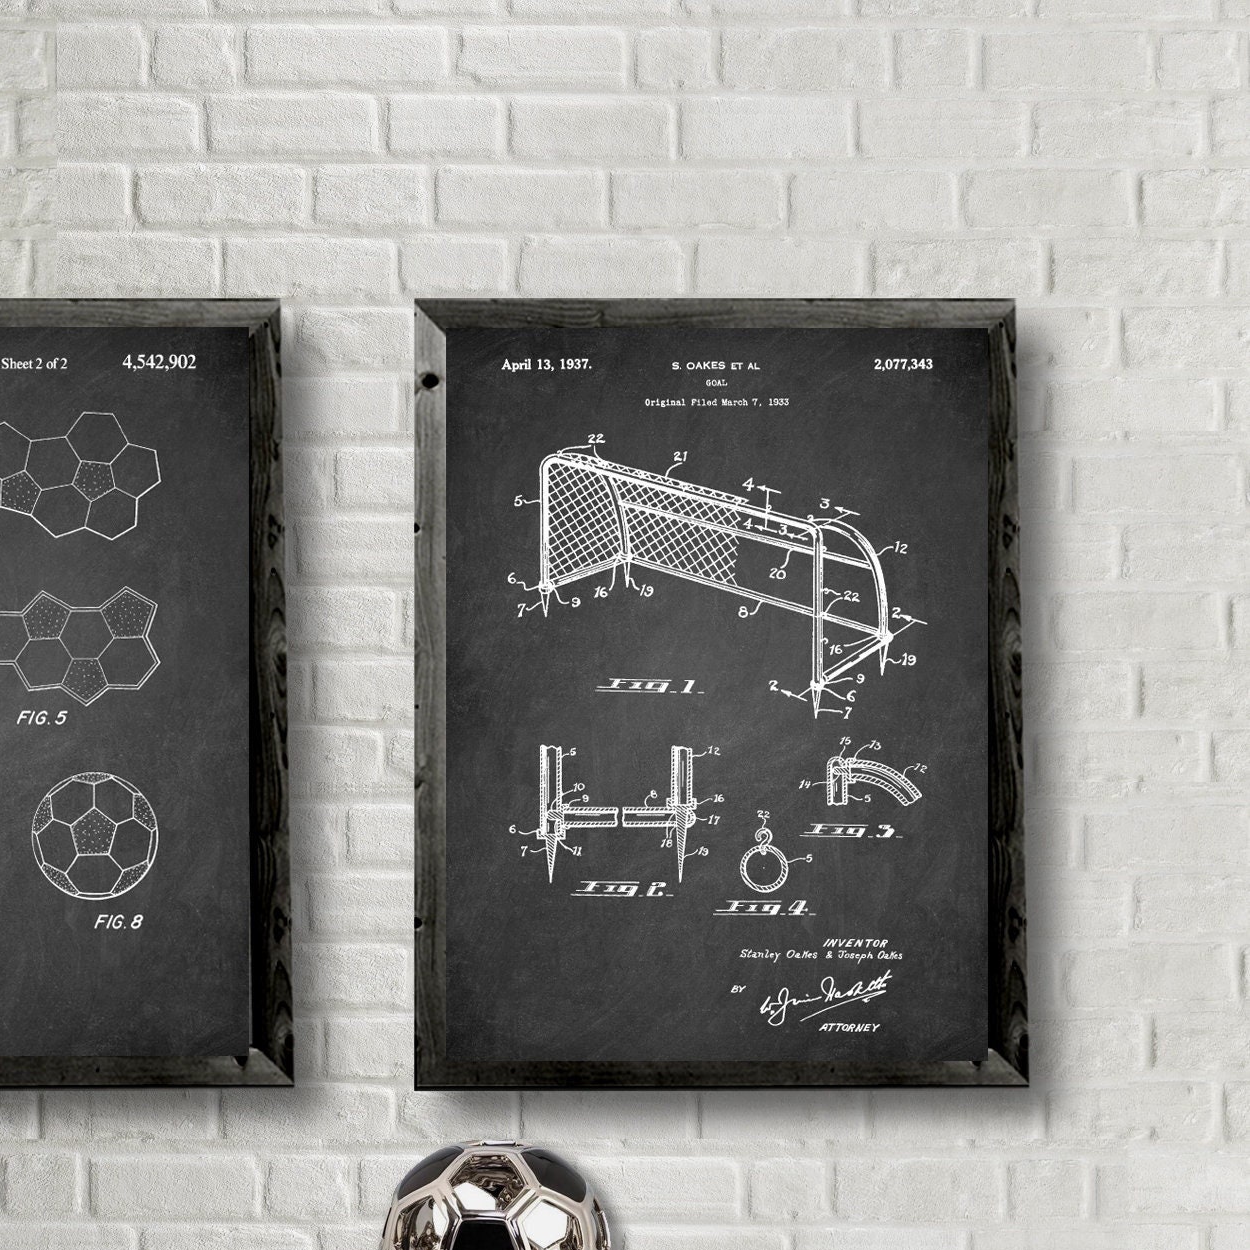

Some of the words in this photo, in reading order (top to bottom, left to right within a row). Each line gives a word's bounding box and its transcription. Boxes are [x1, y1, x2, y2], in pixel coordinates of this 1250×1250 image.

[0, 357, 34, 370] Sheet
[35, 357, 43, 370] 2
[45, 357, 60, 370] of
[59, 357, 68, 370] 2
[121, 353, 197, 372] 4,542,902
[500, 357, 532, 373] April
[536, 358, 555, 372] 13,
[559, 358, 593, 370] 1937.
[671, 361, 682, 371] S.
[685, 360, 726, 371] OAKES
[730, 361, 744, 371] ET
[747, 361, 761, 371] AL
[873, 358, 934, 372] 2,077,343
[705, 378, 728, 387] GOAL
[644, 397, 686, 408] Original
[690, 397, 718, 407] Filed
[721, 397, 749, 407] March
[751, 397, 762, 408] 7,
[768, 397, 790, 407] 1933
[587, 432, 606, 445] 22
[673, 450, 688, 462] 21
[741, 476, 755, 492] 4
[513, 494, 525, 507] 5
[819, 497, 831, 510] 3
[742, 517, 754, 530] 4
[894, 540, 909, 555] 12
[507, 571, 518, 585] 6
[768, 566, 787, 580] 20
[593, 585, 609, 599] 16
[639, 583, 655, 598] 19
[843, 589, 861, 603] 22
[571, 596, 582, 608] 9
[517, 602, 527, 618] 7
[737, 605, 749, 619] 8
[891, 606, 902, 620] 2
[828, 644, 843, 656] 16
[900, 652, 917, 667] 19
[768, 679, 779, 692] 2
[855, 673, 866, 685] 9
[846, 689, 857, 703] 6
[16, 709, 51, 726] FIG.
[54, 710, 69, 726] 5
[843, 705, 853, 720] 7
[839, 736, 852, 746] 15
[868, 739, 882, 751] 13
[707, 745, 722, 756] 12
[912, 762, 928, 774] 12
[571, 782, 586, 793] 10
[581, 793, 590, 803] 9
[713, 793, 725, 803] 16
[707, 814, 721, 826] 17
[756, 809, 771, 820] 22
[508, 824, 517, 834] 6
[660, 837, 673, 849] 18
[696, 845, 710, 857] 19
[804, 853, 813, 864] 5
[93, 913, 127, 930] FIG.
[130, 913, 144, 930] 8
[822, 938, 889, 949] INVENTOR
[738, 948, 782, 964] Stanley
[825, 950, 833, 960] &
[837, 949, 874, 965] Joseph
[730, 984, 747, 994] BY
[818, 1022, 881, 1033] ATTORNEY
